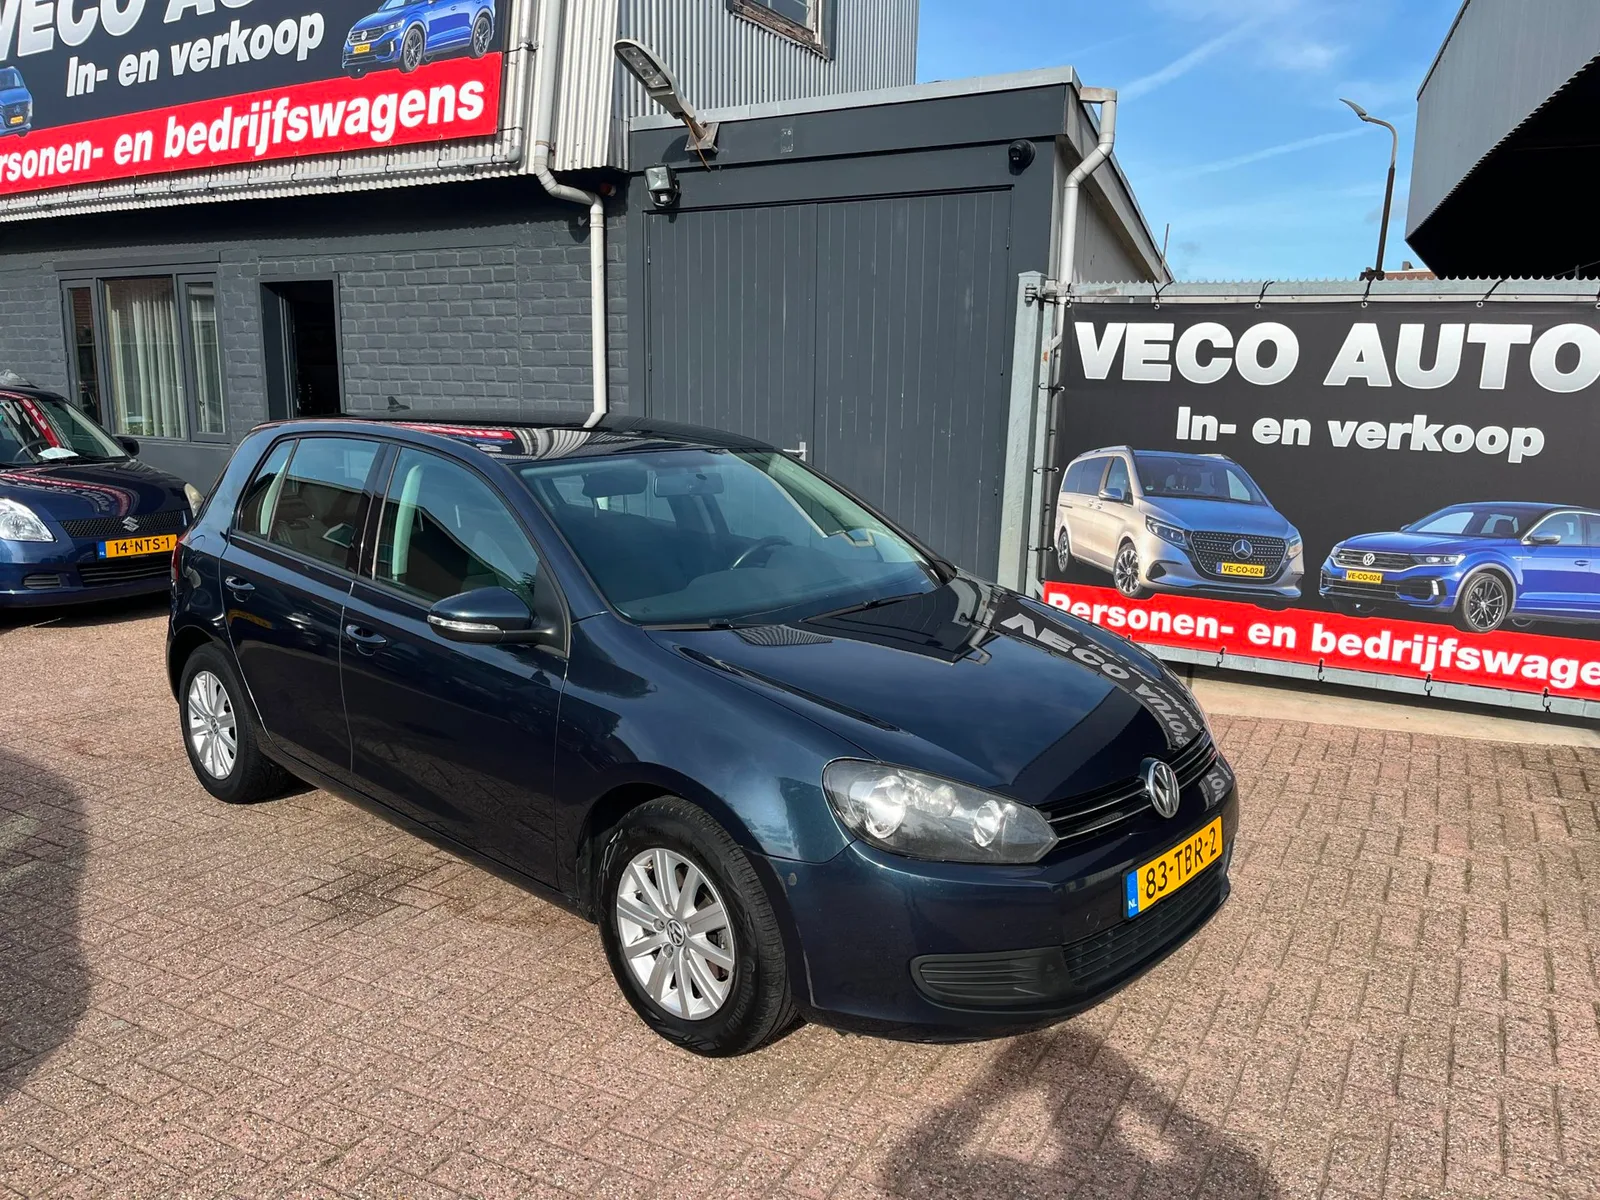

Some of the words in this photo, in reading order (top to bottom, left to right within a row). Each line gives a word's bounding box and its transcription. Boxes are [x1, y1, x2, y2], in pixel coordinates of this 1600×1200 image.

[66, 56, 108, 97] In-
[118, 49, 159, 87] en
[170, 12, 325, 76] verkoop
[114, 129, 153, 165] en
[164, 80, 485, 156] bedrijfswagens
[1074, 322, 1300, 386] VECO
[1322, 322, 1600, 393] AUTO
[1175, 406, 1237, 441] In-
[1252, 414, 1311, 446] en
[1327, 414, 1545, 463] verkoop
[1223, 565, 1263, 575] VE-CO-024
[1347, 572, 1381, 582] VE-CO-024
[1247, 623, 1296, 649] en
[1311, 623, 1600, 689] bedrijfswage
[1145, 826, 1217, 899] 83-TBR-2
[1128, 899, 1137, 909] NL
